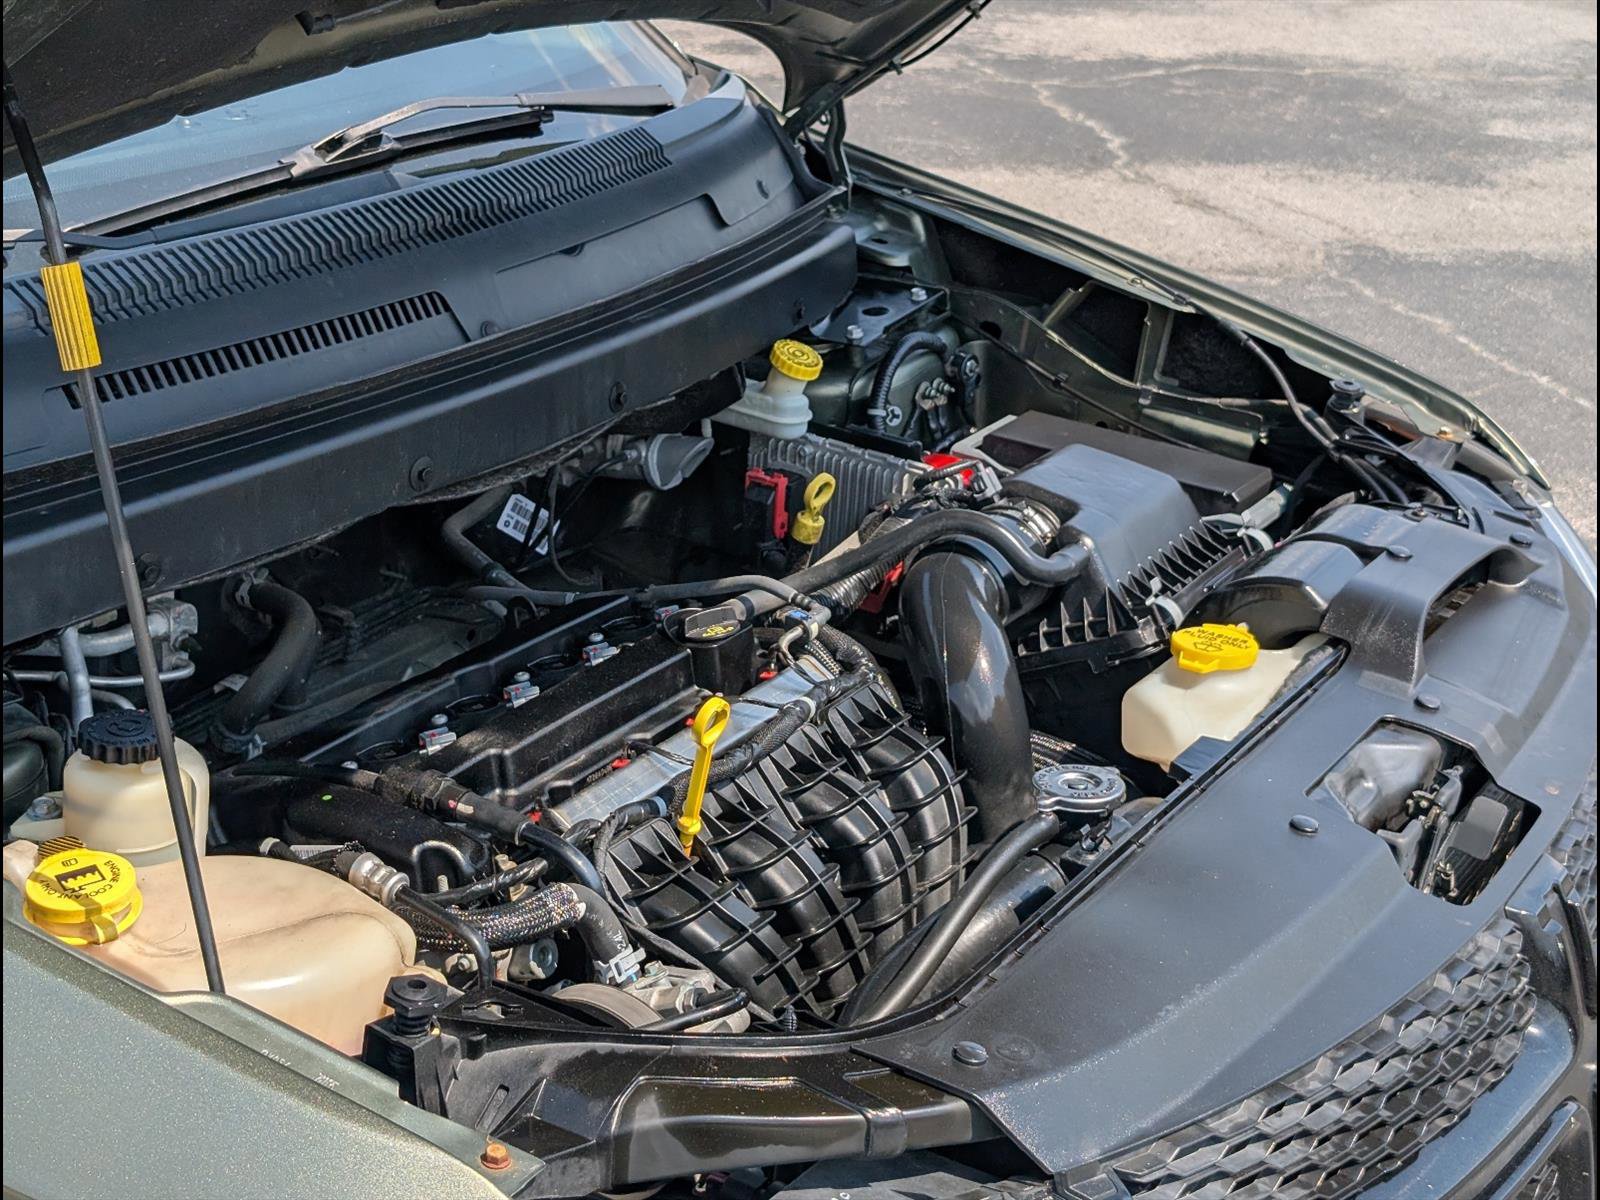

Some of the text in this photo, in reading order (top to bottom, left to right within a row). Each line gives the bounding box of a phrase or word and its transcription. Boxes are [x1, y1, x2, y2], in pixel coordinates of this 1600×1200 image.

[1183, 630, 1250, 650] FLUID ONLY
[1197, 628, 1248, 644] WASHER
[39, 860, 121, 900] ENGINE COOLANT ONLY
